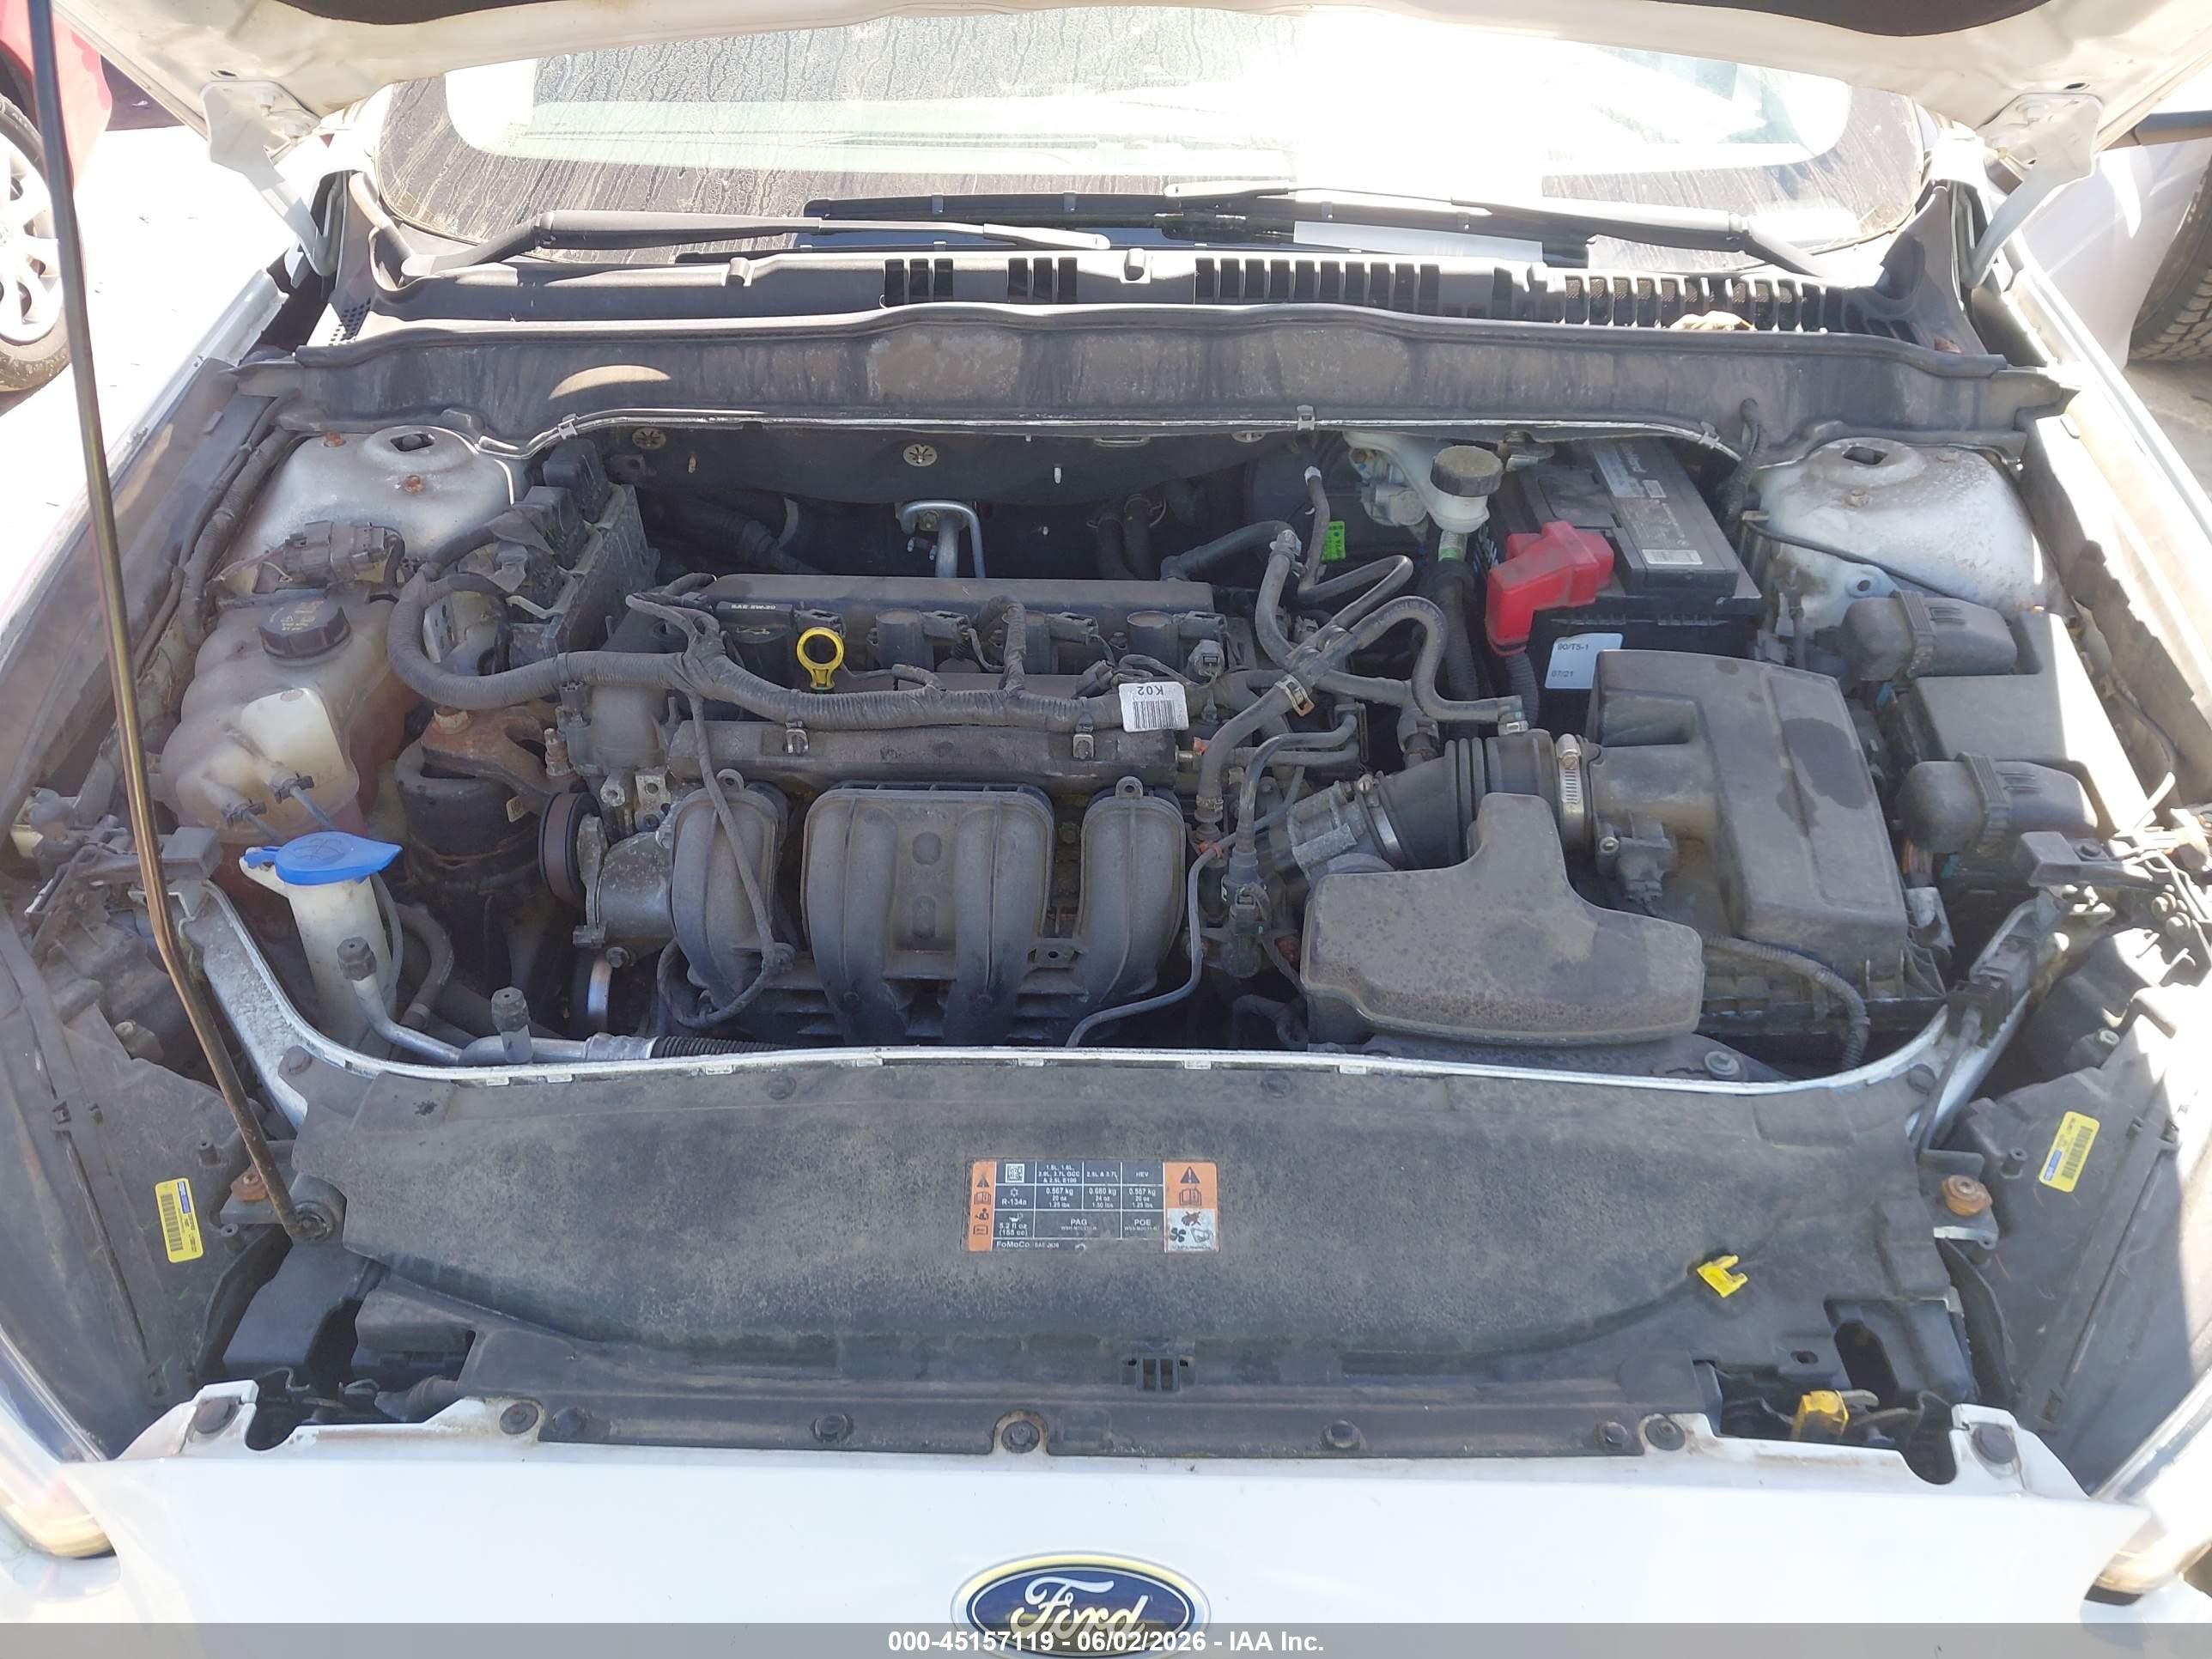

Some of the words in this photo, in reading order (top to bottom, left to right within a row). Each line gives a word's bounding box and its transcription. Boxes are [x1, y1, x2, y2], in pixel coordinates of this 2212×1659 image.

[1136, 685, 1164, 696] K02
[1065, 1187, 1073, 1196] kg
[1108, 1188, 1117, 1196] kg
[1009, 1577, 1149, 1638] Ford
